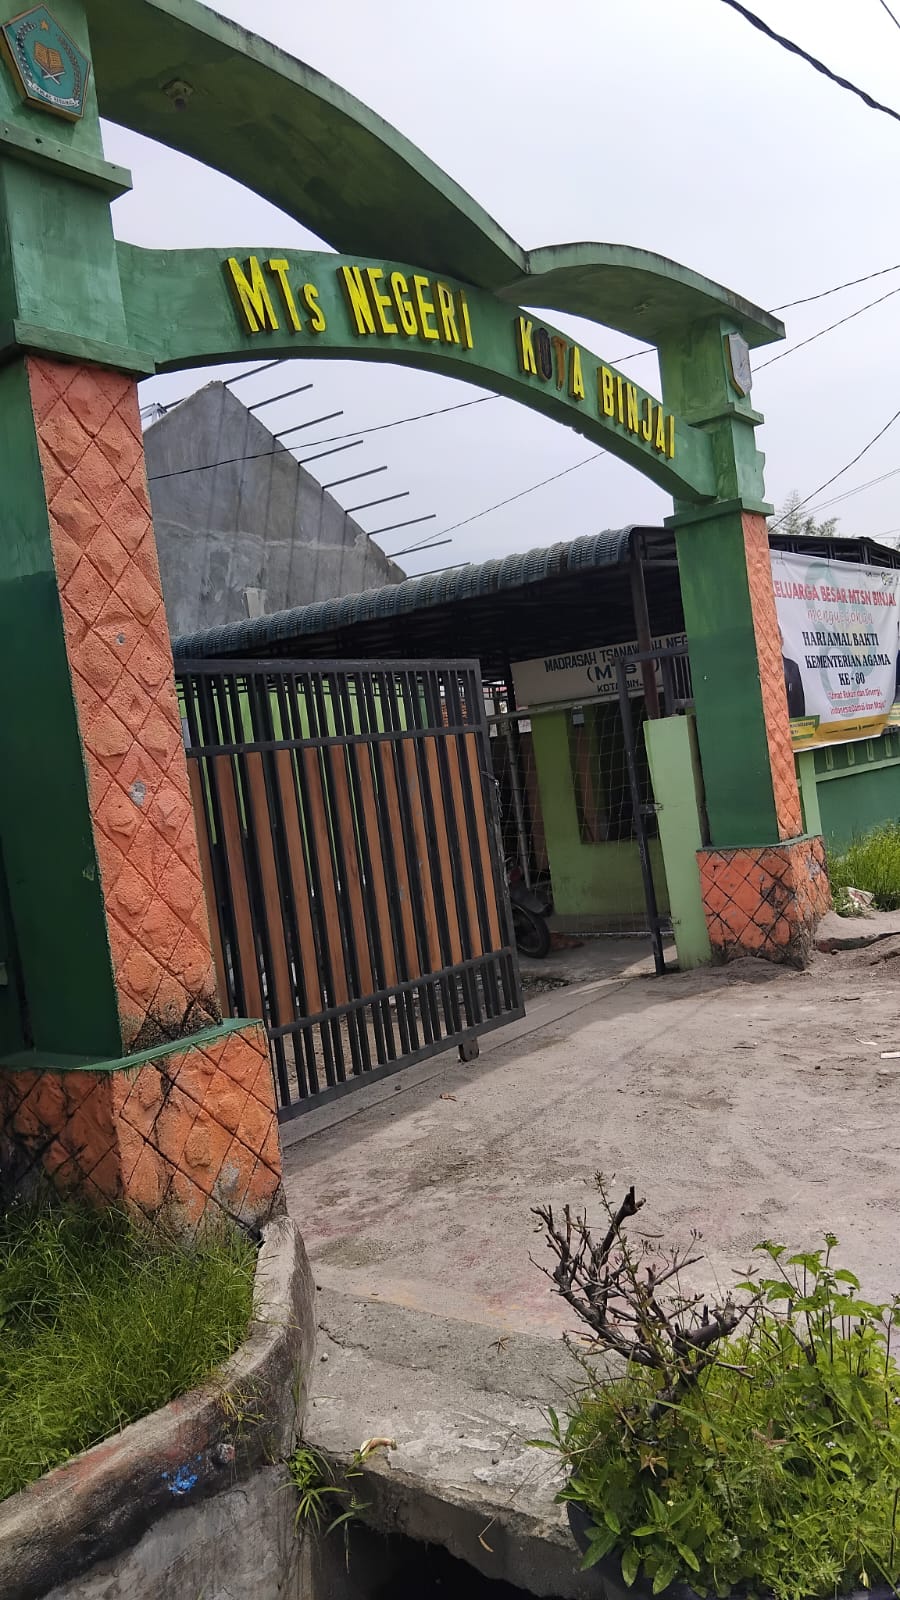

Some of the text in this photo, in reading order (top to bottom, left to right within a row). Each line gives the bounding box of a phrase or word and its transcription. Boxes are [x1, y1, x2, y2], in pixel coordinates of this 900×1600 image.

[226, 256, 675, 459] MTs NEGERI KOTA BINJAI
[774, 579, 897, 607] ELUARGA BESAR MTSN BINJAI
[802, 631, 880, 647] HARI AMAL BAKTI
[544, 651, 597, 673] MADRASAH
[804, 653, 892, 669] KEMENTERIAN AGAMA
